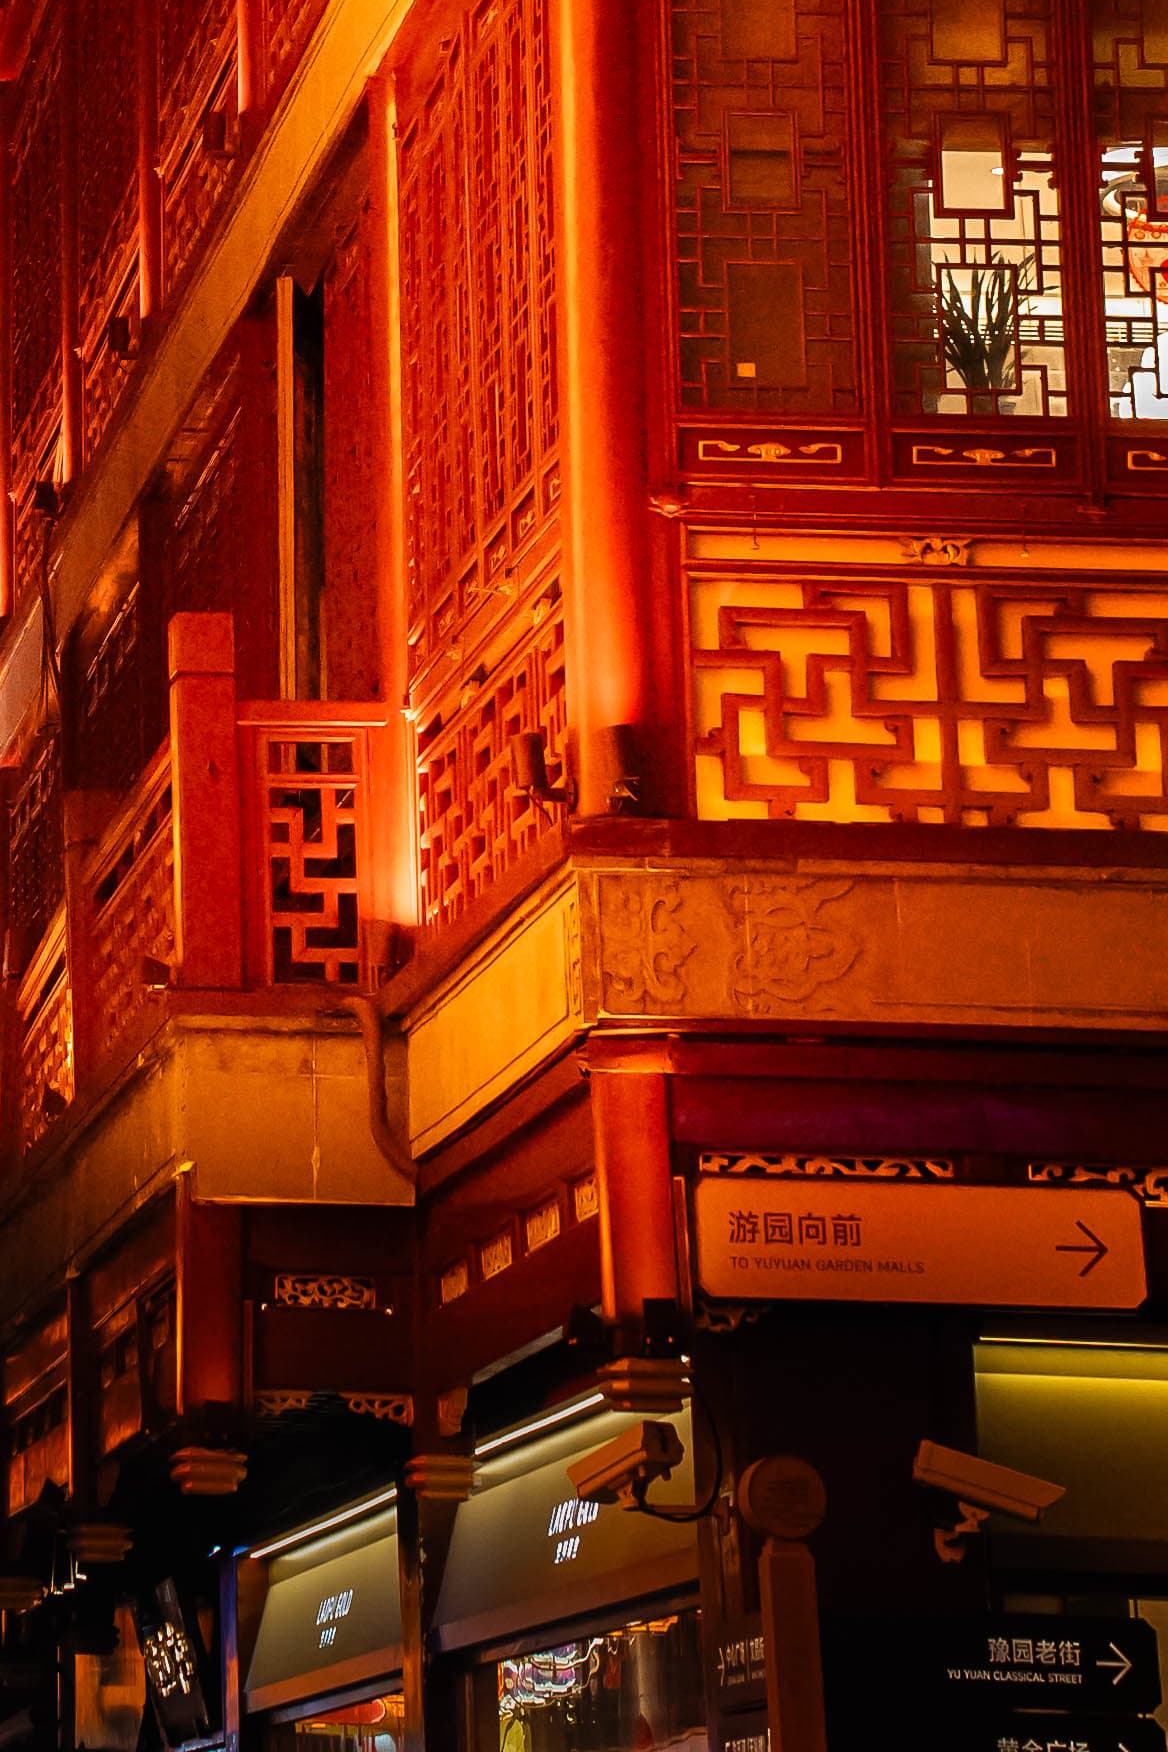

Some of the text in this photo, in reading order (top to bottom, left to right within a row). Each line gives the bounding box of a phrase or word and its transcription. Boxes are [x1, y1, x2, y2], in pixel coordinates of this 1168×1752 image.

[728, 1210, 863, 1247] 游园向前
[729, 1256, 925, 1275] TO YUYUAN GARDEN MALLS
[987, 1636, 1081, 1667] 豫园老街
[947, 1668, 1083, 1685] YU YUAN CLASSICAL STREET
